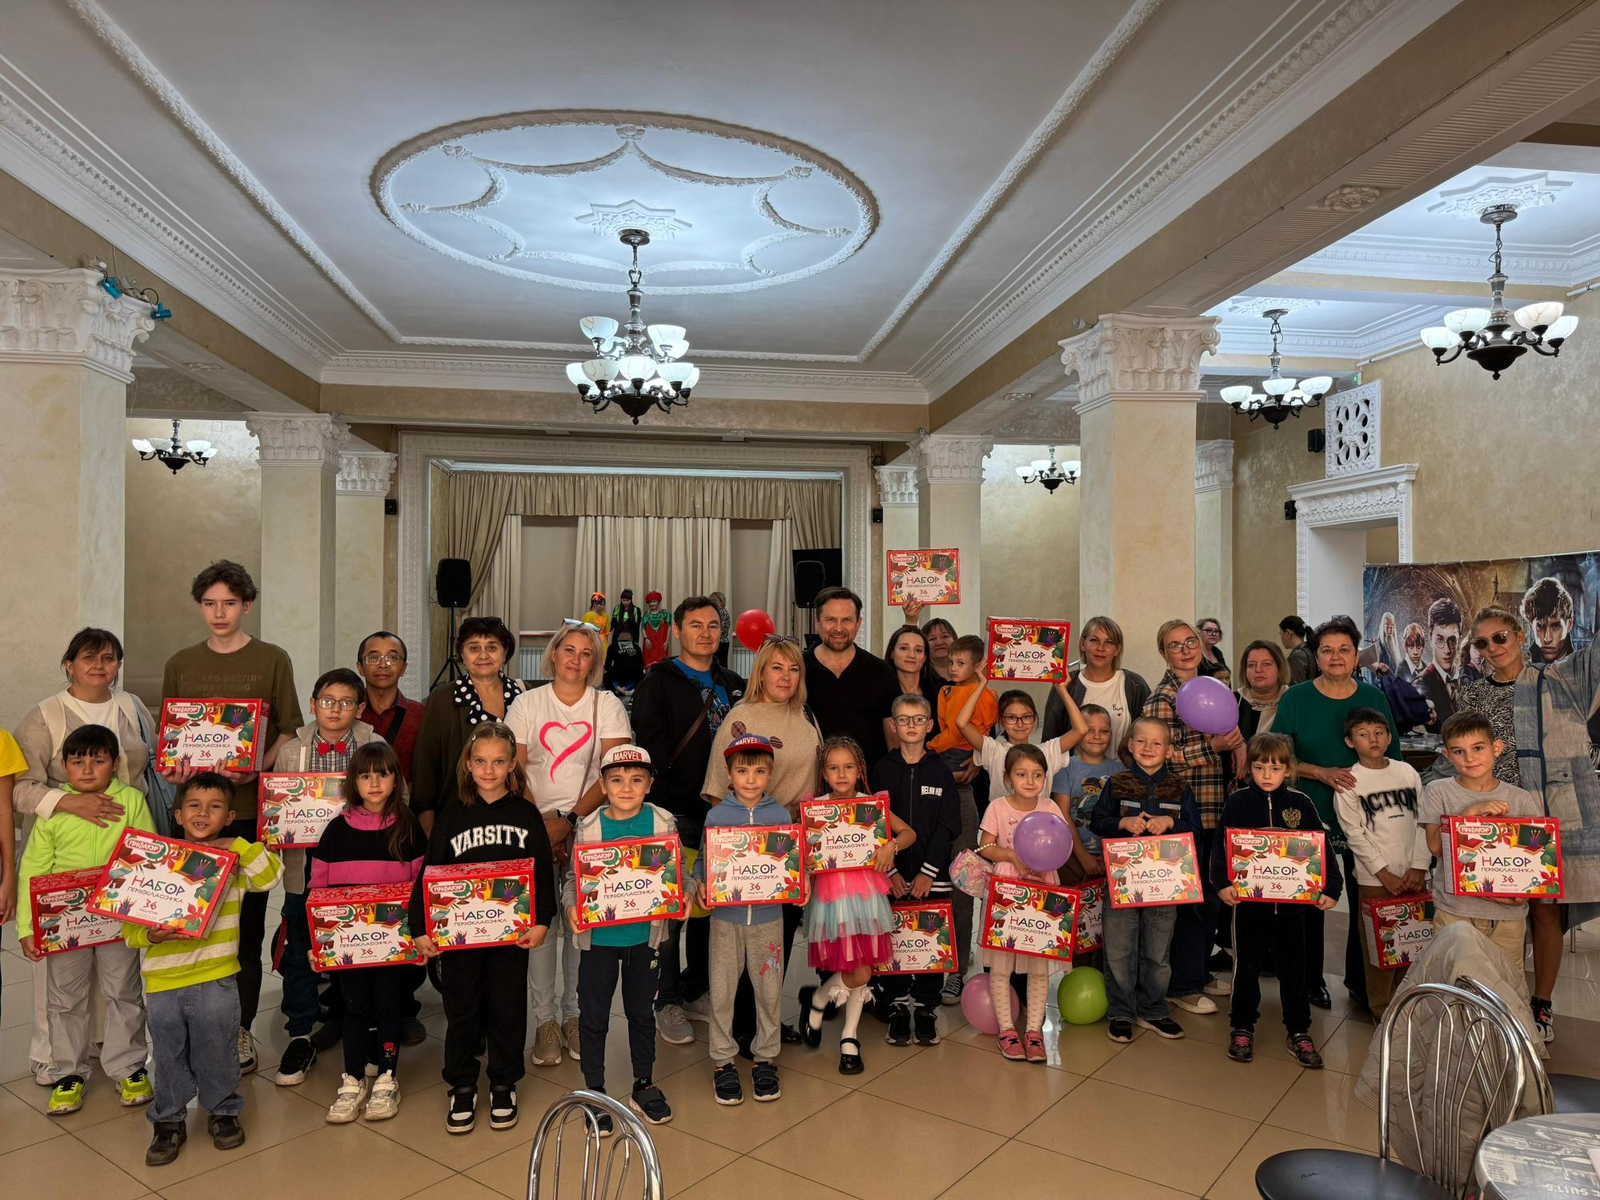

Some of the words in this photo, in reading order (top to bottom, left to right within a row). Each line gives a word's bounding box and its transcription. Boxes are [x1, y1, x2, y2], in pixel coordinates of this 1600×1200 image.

[907, 576, 940, 584] НАБОР
[1009, 651, 1045, 660] НАБОР
[184, 733, 230, 743] НАБОР
[200, 750, 212, 758] 36
[614, 750, 642, 762] MARVEL
[1358, 787, 1419, 819] ACTION
[285, 808, 334, 819] НАБОР
[303, 825, 316, 834] 36
[450, 824, 529, 857] VARSITY
[826, 833, 867, 845] НАБОР
[843, 851, 854, 859] 36
[1481, 857, 1532, 867] НАБОР
[732, 863, 777, 875] НАБОР
[1131, 868, 1173, 880] НАБОР
[1253, 865, 1299, 876] НАБОР
[1501, 875, 1515, 883] 36
[131, 875, 186, 896] НАБОР
[604, 878, 653, 894] НАБОР
[749, 882, 761, 891] 36
[1149, 885, 1160, 893] 36
[1270, 882, 1282, 890] 36
[142, 899, 158, 910] 36
[623, 899, 637, 908] 36
[454, 909, 505, 921] НАБОР
[1010, 916, 1052, 930] НАБОР
[88, 927, 102, 936] 36
[474, 927, 487, 935] 36
[340, 931, 390, 943] НАБОР
[1023, 935, 1034, 943] 36
[361, 948, 373, 956] 36
